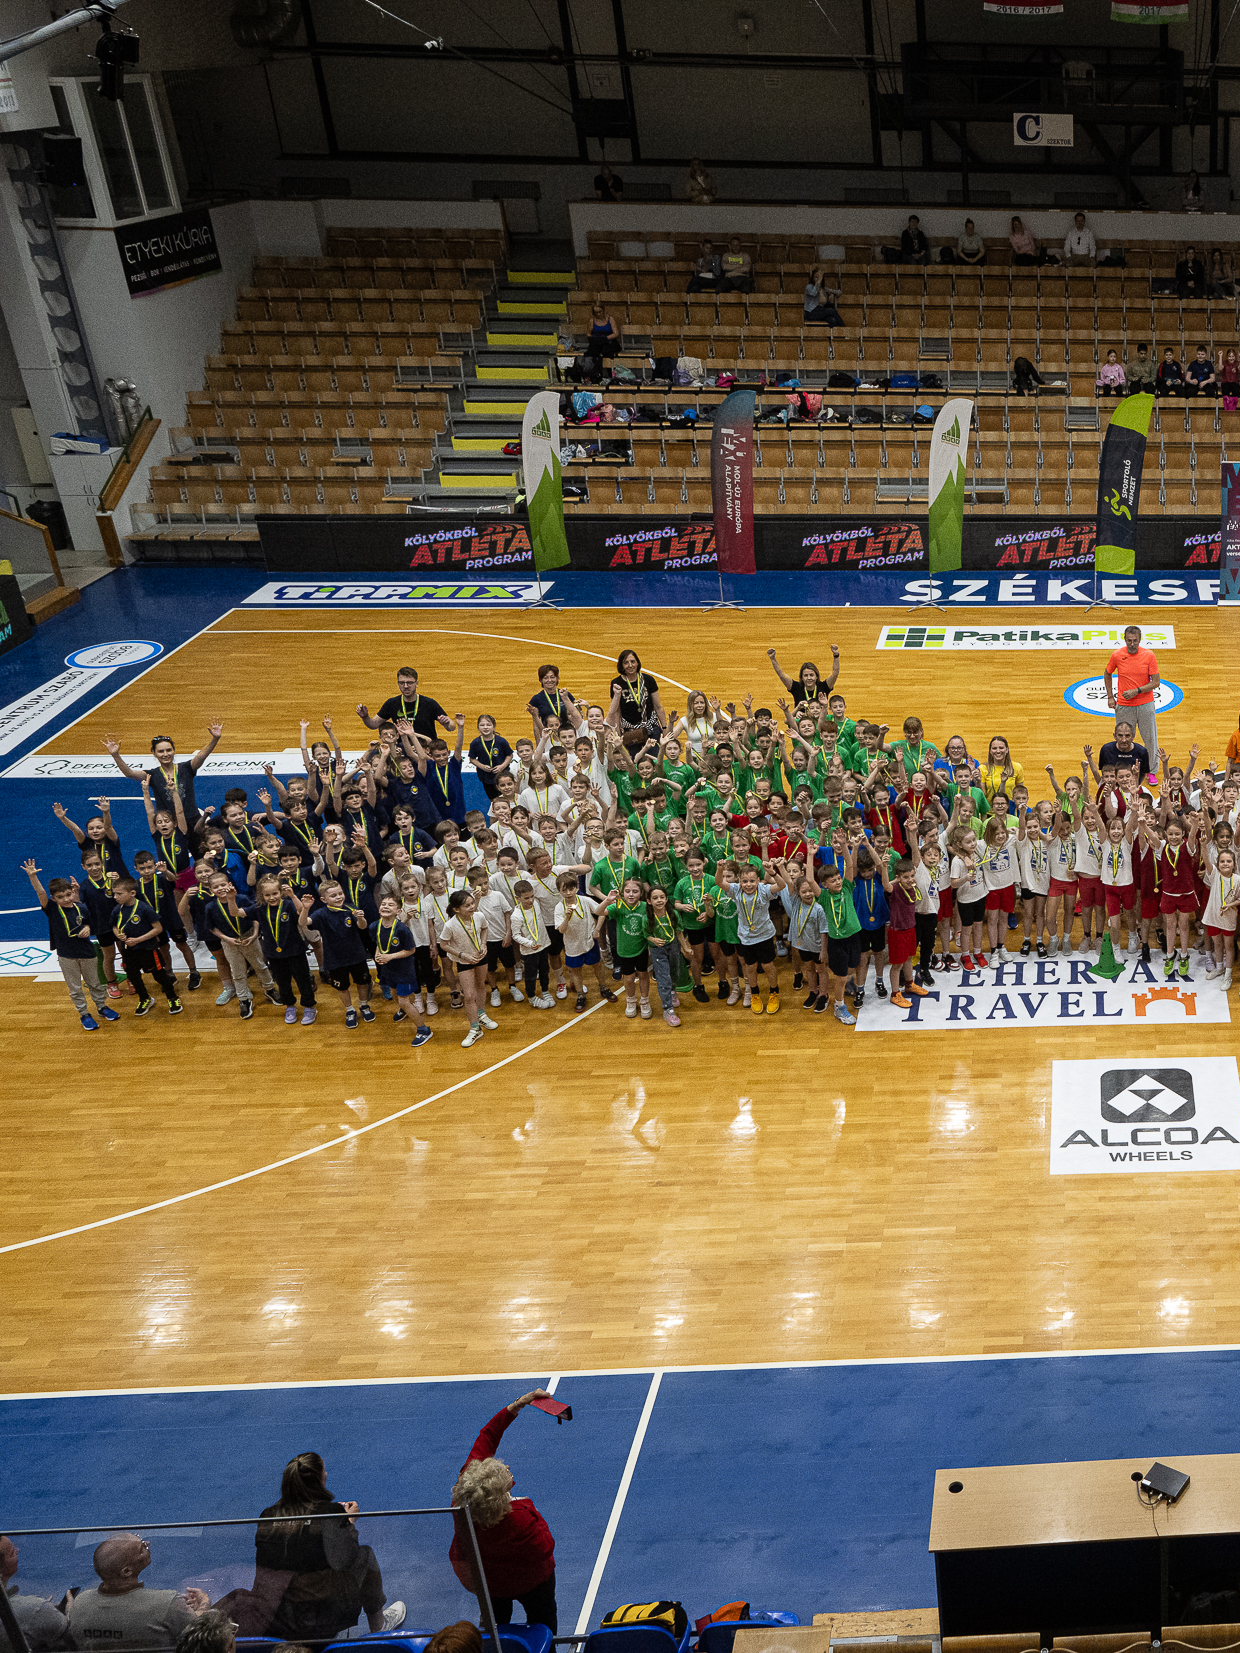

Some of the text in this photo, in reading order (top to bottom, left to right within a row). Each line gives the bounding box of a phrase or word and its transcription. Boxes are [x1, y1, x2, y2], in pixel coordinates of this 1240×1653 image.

[996, 5, 1019, 14] 2016
[1028, 6, 1051, 15] 2017
[1138, 6, 1162, 16] 2017
[1016, 114, 1044, 144] C
[1046, 138, 1072, 146] SZEKTOR
[124, 226, 213, 264] ETYEKI KÚRIA
[1121, 459, 1132, 499] SPORTOLÓ
[724, 464, 734, 521] ALAPÍTVÁNY
[733, 465, 743, 535] MOL-ÚJ EURÓPA
[1128, 475, 1138, 506] NEMZET
[404, 526, 479, 547] KÖLYÖKBŐL
[605, 526, 678, 547] KÖLYÖKBŐL
[801, 526, 875, 547] KÖLYÖKBŐL
[994, 526, 1067, 547] KÖLYÖKBŐL
[465, 550, 533, 570] PROGRAM
[858, 550, 924, 569] PROGRAM
[43, 670, 84, 693] SZABÓ
[205, 760, 276, 768] DEPÓNIA
[901, 990, 1123, 1023] TRAVEL
[1059, 1126, 1240, 1149] ALCOA
[1108, 1151, 1193, 1162] WHEELS
